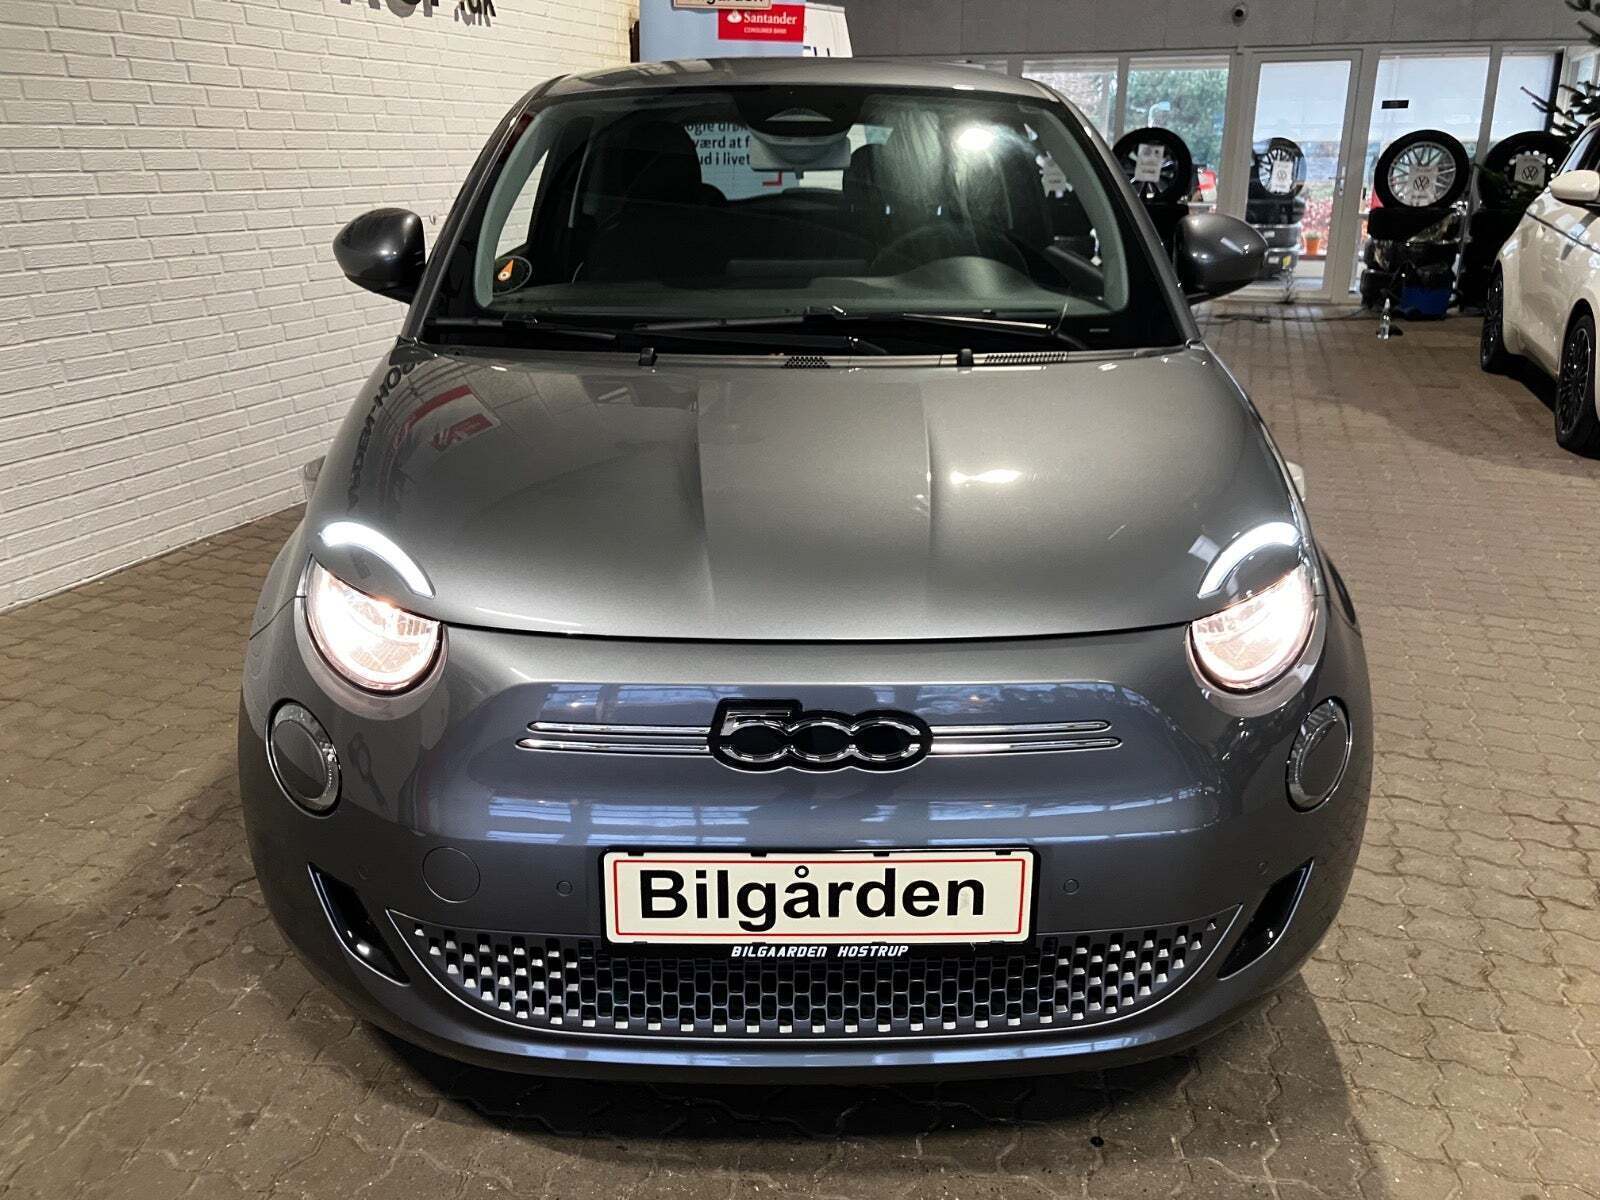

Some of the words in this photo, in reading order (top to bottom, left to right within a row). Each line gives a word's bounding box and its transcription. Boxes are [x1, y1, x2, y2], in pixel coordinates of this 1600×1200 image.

[743, 11, 798, 25] Santander
[687, 122, 714, 136] ogle
[729, 137, 742, 149] at
[723, 152, 751, 165] livet
[714, 704, 926, 767] 500
[639, 865, 986, 933] Bilgården
[731, 945, 828, 958] BILGAARDEN
[837, 944, 909, 958] HOSTRUP
